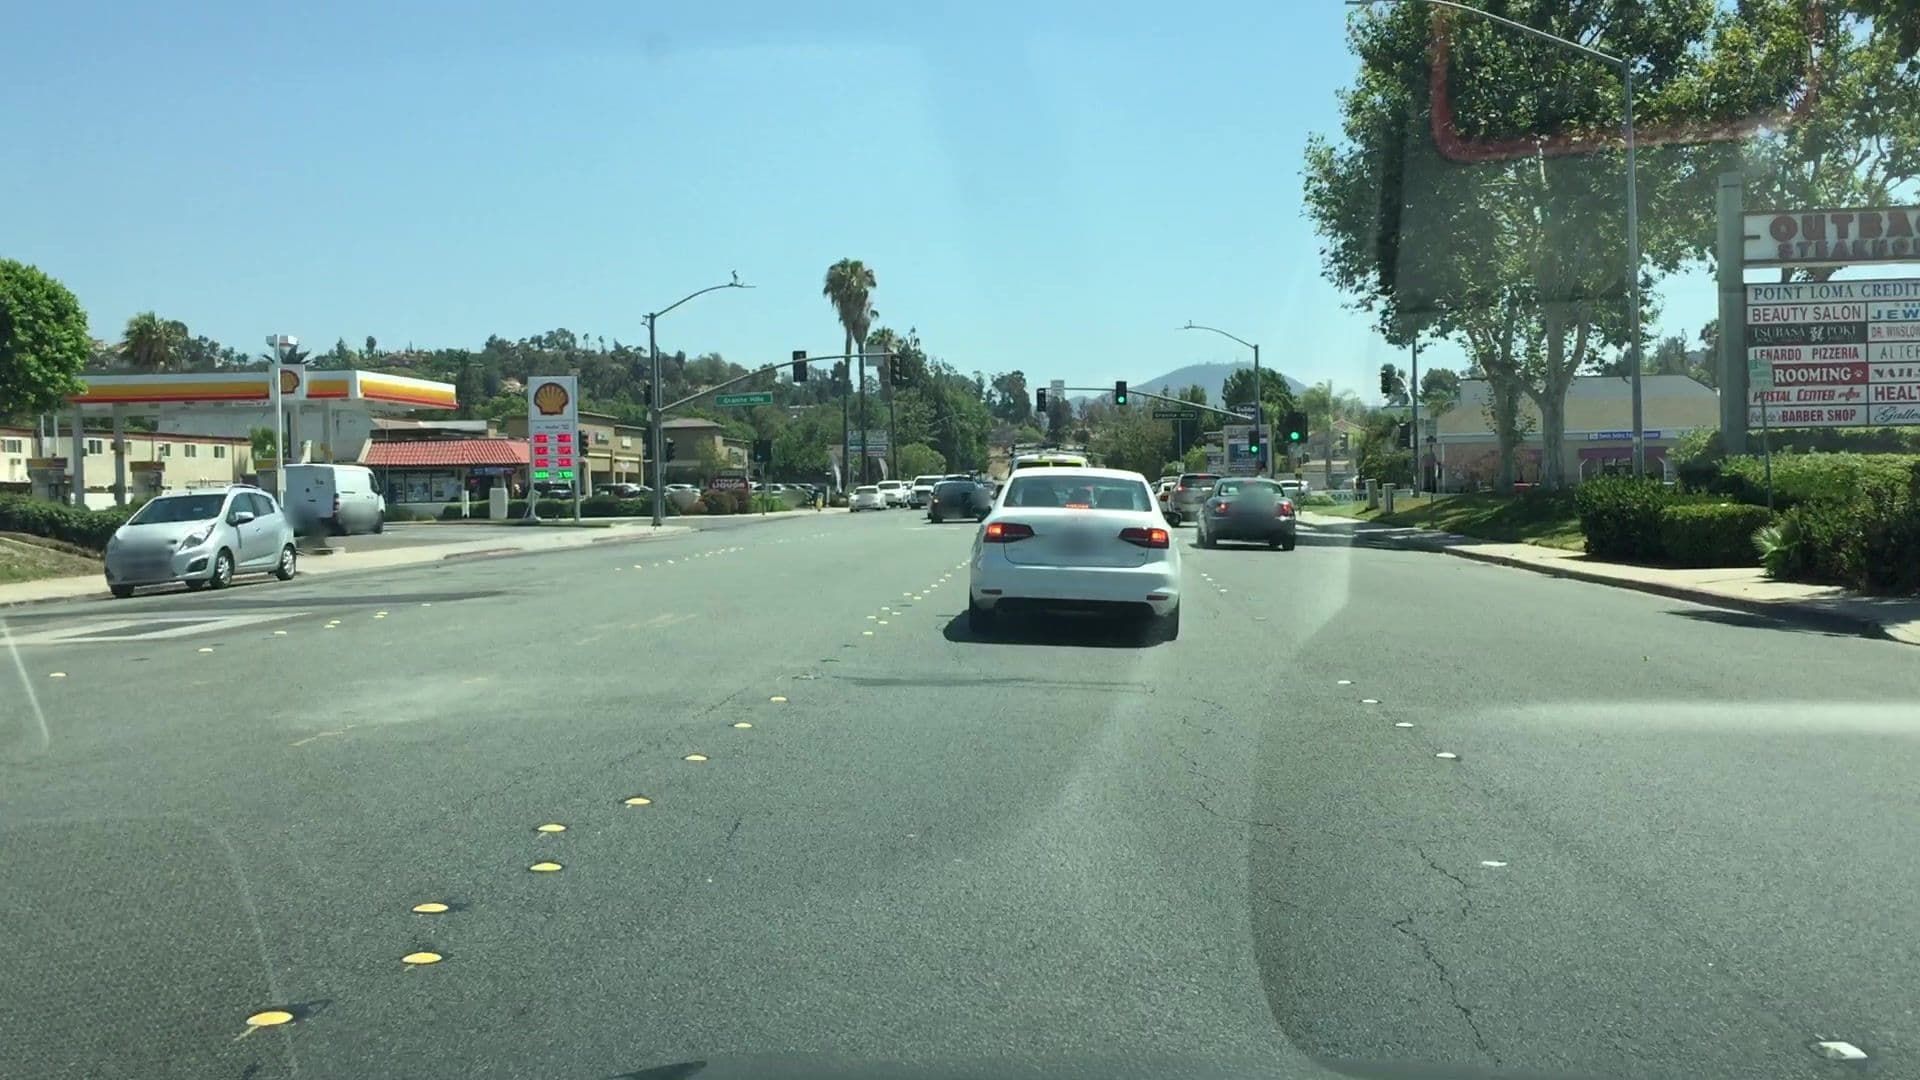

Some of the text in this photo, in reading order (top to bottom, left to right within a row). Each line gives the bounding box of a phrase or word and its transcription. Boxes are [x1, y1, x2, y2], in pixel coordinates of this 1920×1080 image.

[1769, 211, 1920, 242] OUTBA
[1754, 282, 1920, 301] POINT LOMA CREDIT
[1752, 305, 1861, 322] BEAUTY SALON
[1811, 346, 1859, 360] PIZZERIA
[1774, 366, 1852, 384] ROOMING
[1797, 388, 1836, 401] CENTER
[1781, 410, 1824, 423] BARBER
[1827, 409, 1857, 422] SHOP
